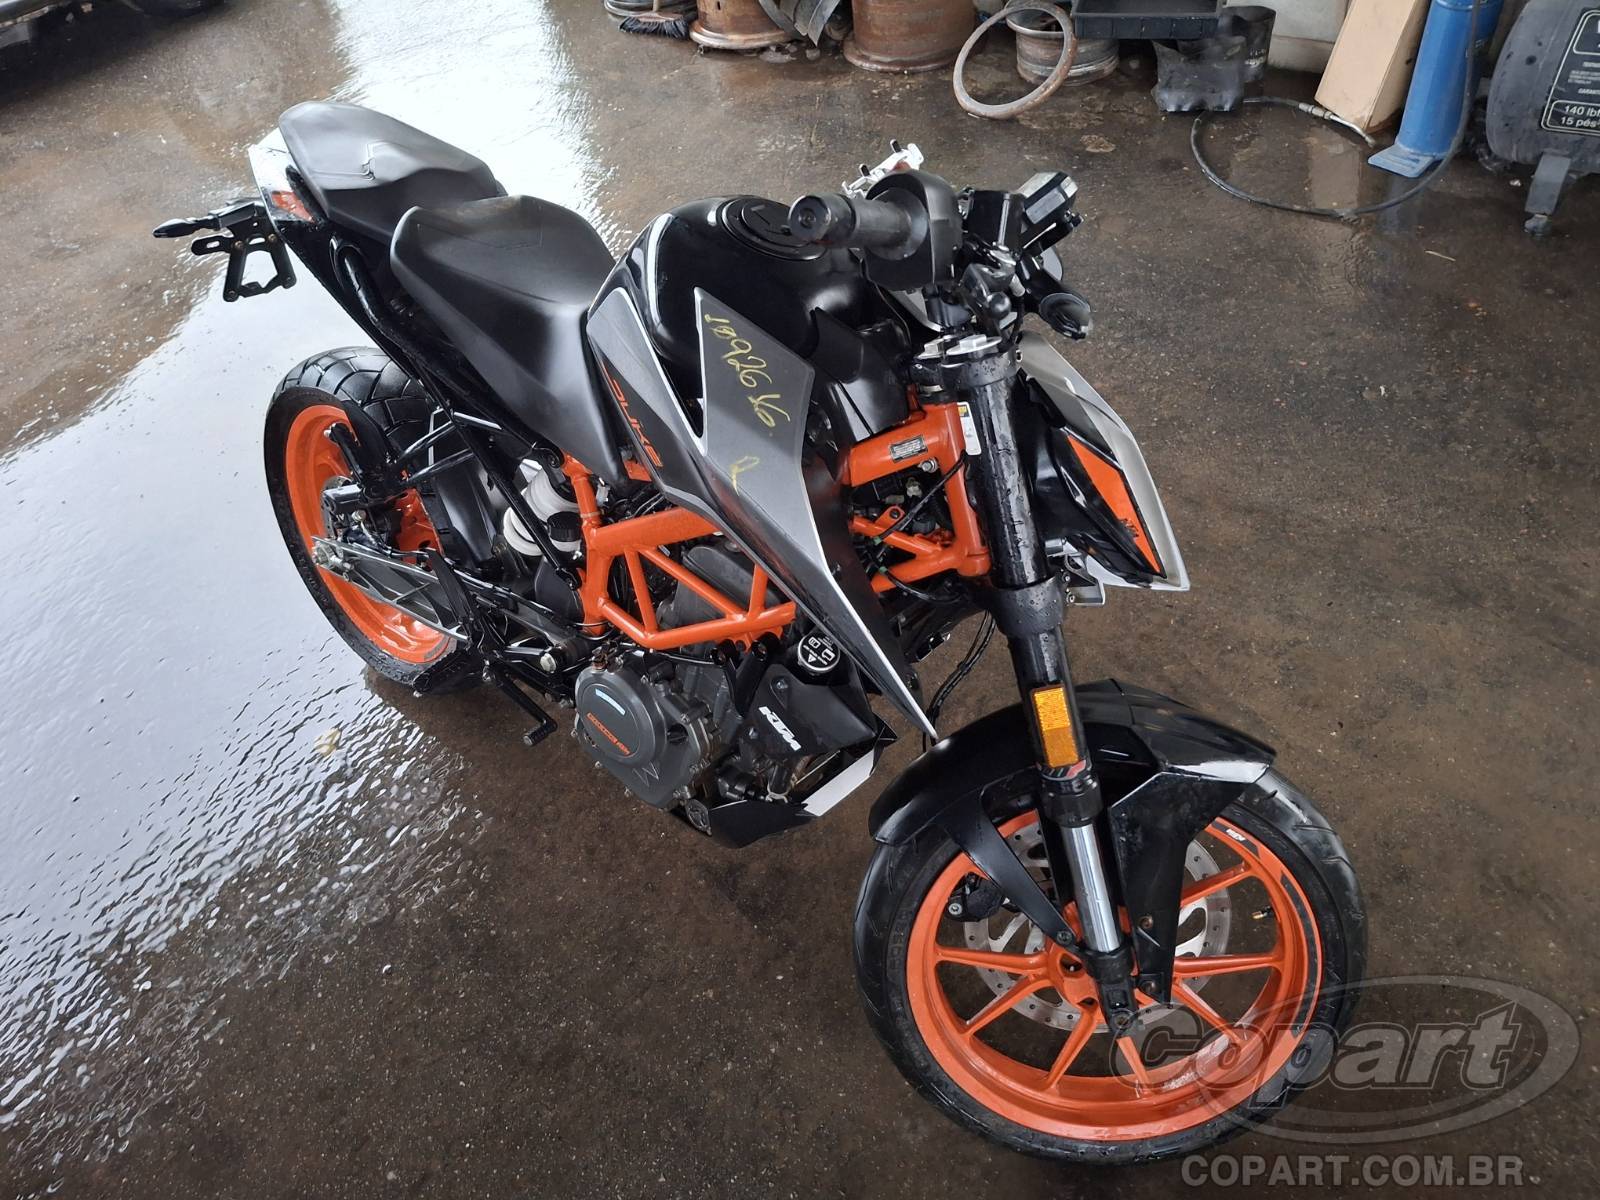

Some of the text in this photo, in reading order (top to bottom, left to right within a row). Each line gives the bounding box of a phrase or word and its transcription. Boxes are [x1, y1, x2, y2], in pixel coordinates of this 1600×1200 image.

[1561, 116, 1575, 125] 15
[1565, 105, 1586, 116] 140
[611, 378, 664, 467] DUKE
[758, 705, 802, 752] KTM
